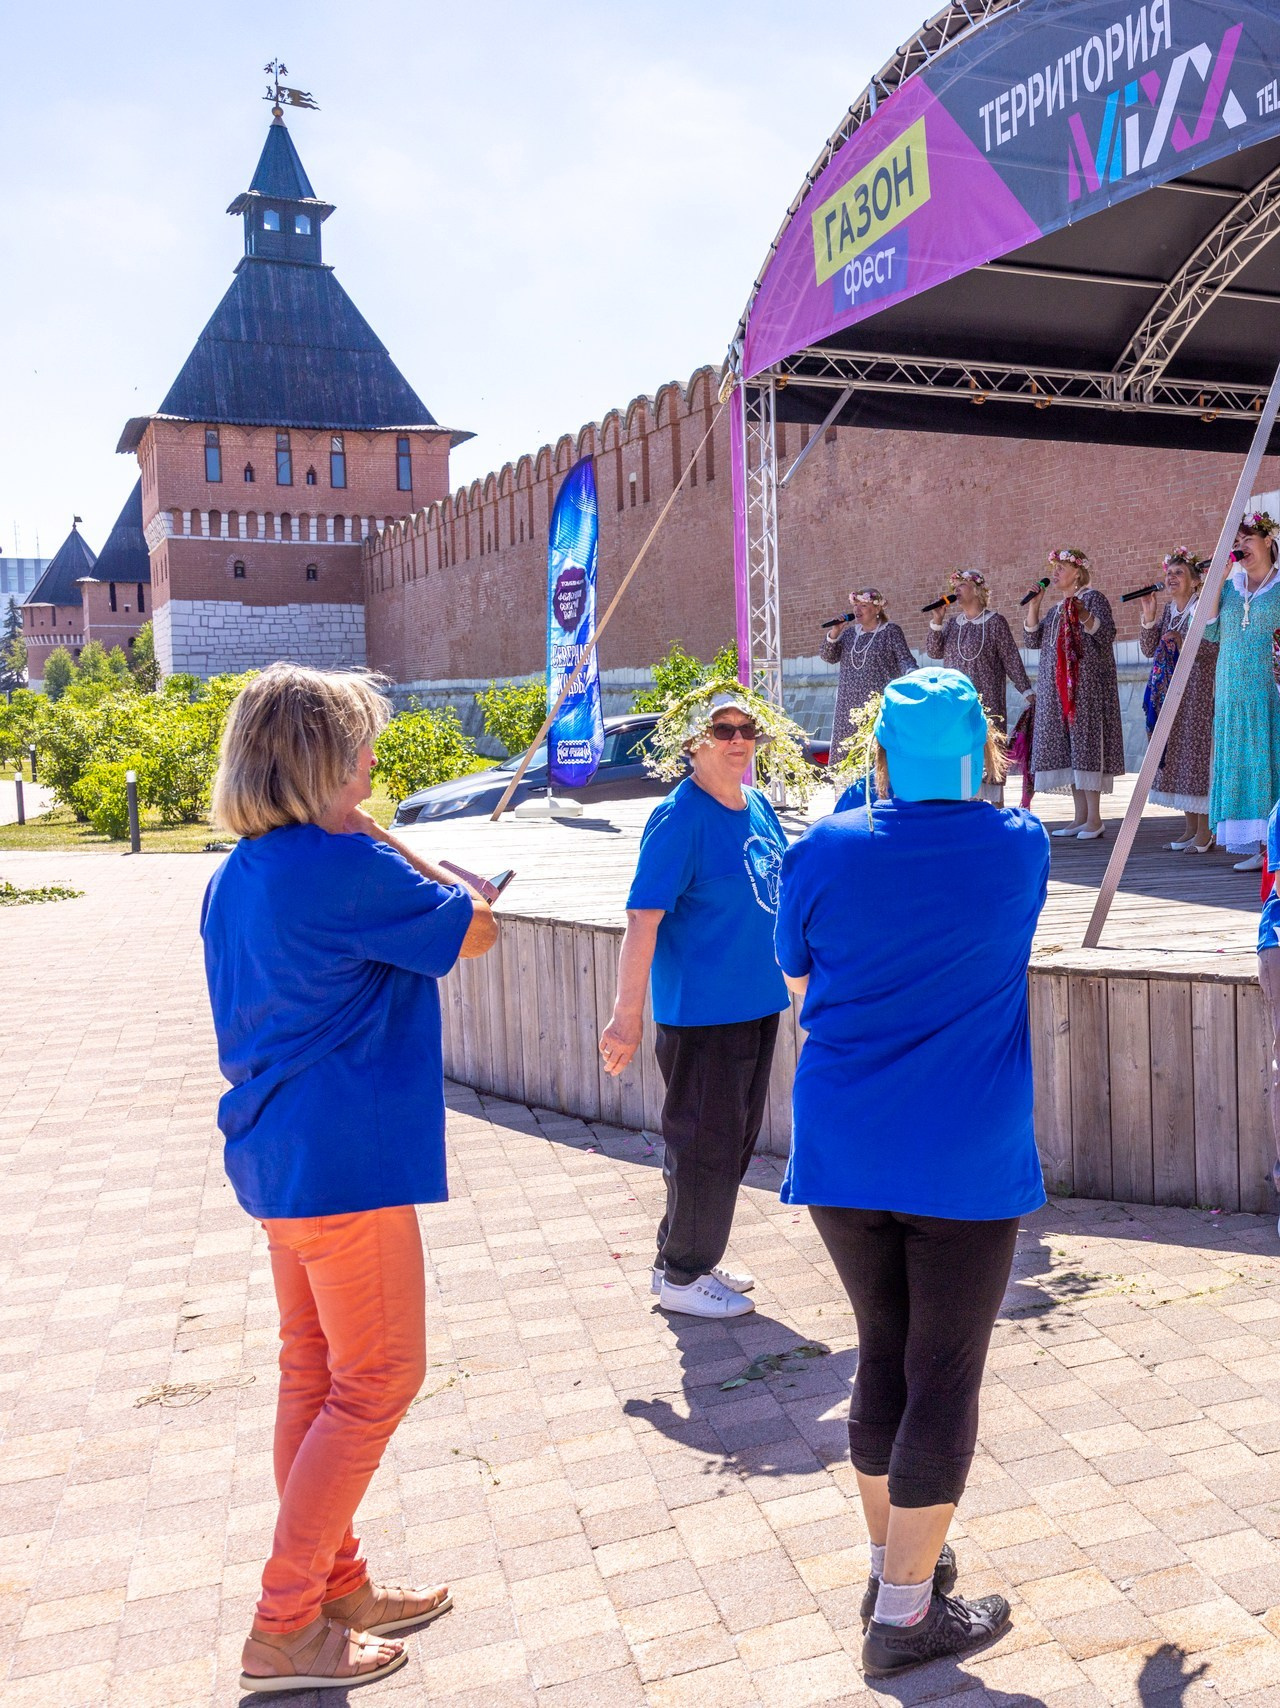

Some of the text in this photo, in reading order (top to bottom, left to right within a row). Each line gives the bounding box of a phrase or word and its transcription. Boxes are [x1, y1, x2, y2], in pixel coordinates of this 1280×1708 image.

[979, 0, 1172, 153] ТЕРРИТОРИЯ
[824, 145, 914, 263] ГАЗОН
[844, 247, 896, 305] фест
